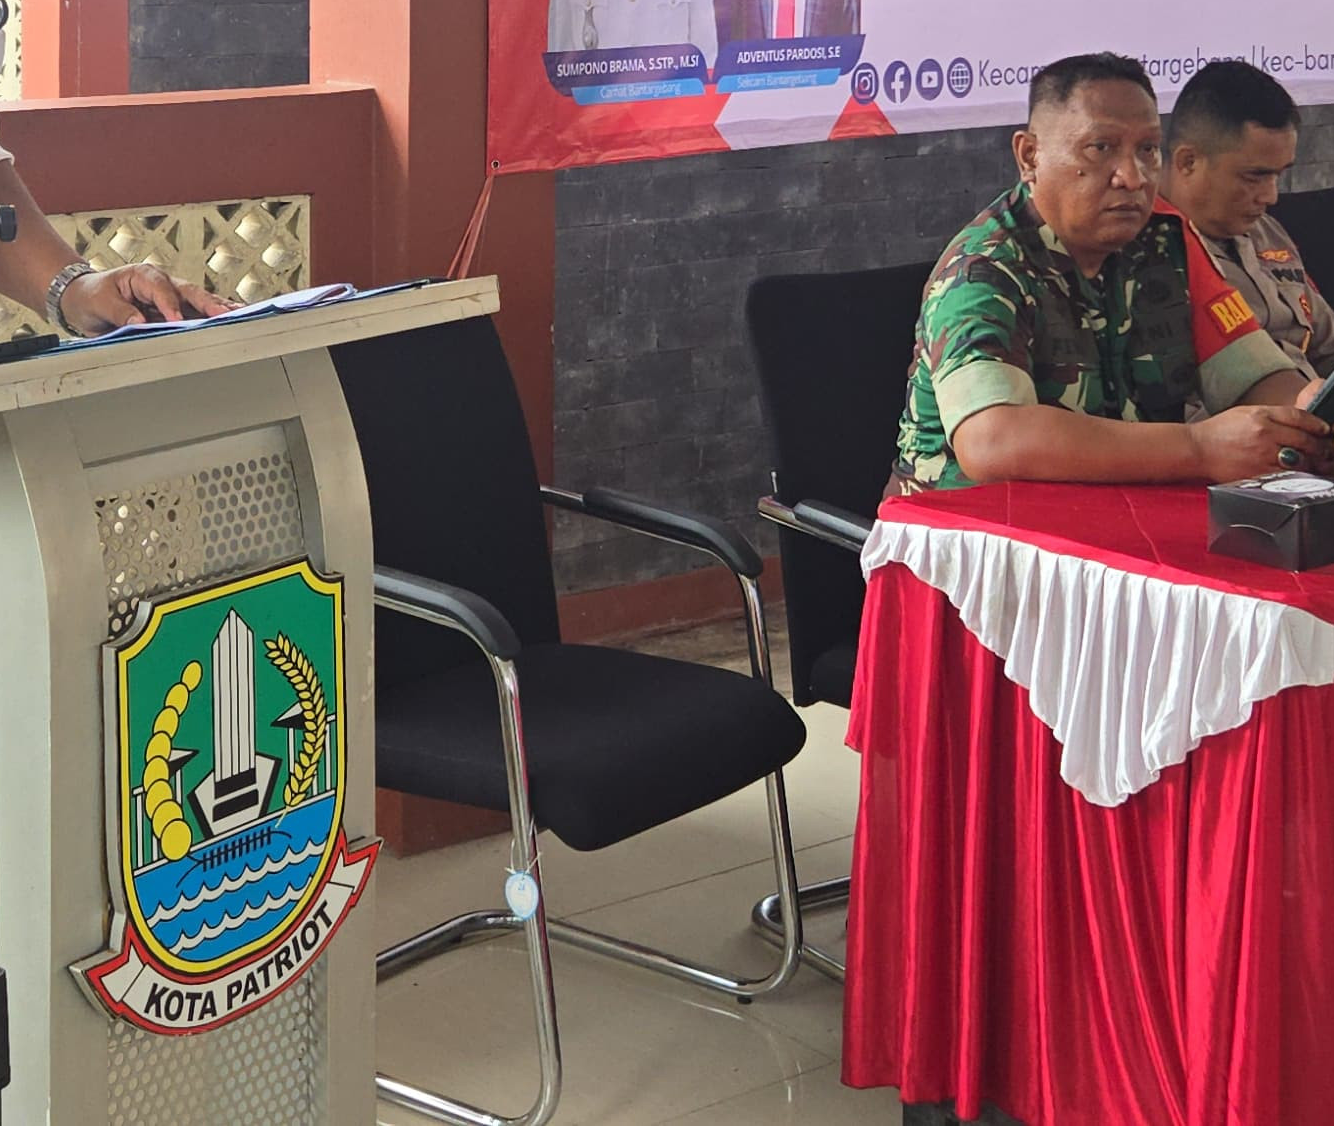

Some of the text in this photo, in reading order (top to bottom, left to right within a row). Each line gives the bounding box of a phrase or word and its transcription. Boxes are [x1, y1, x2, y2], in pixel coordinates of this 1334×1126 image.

[737, 49, 785, 64] ADVENTUS
[786, 47, 827, 61] PARDOSI,
[557, 61, 608, 77] SUMPONO
[609, 58, 647, 73] BRAMA,
[143, 901, 334, 1022] KOTA PATRIOT
